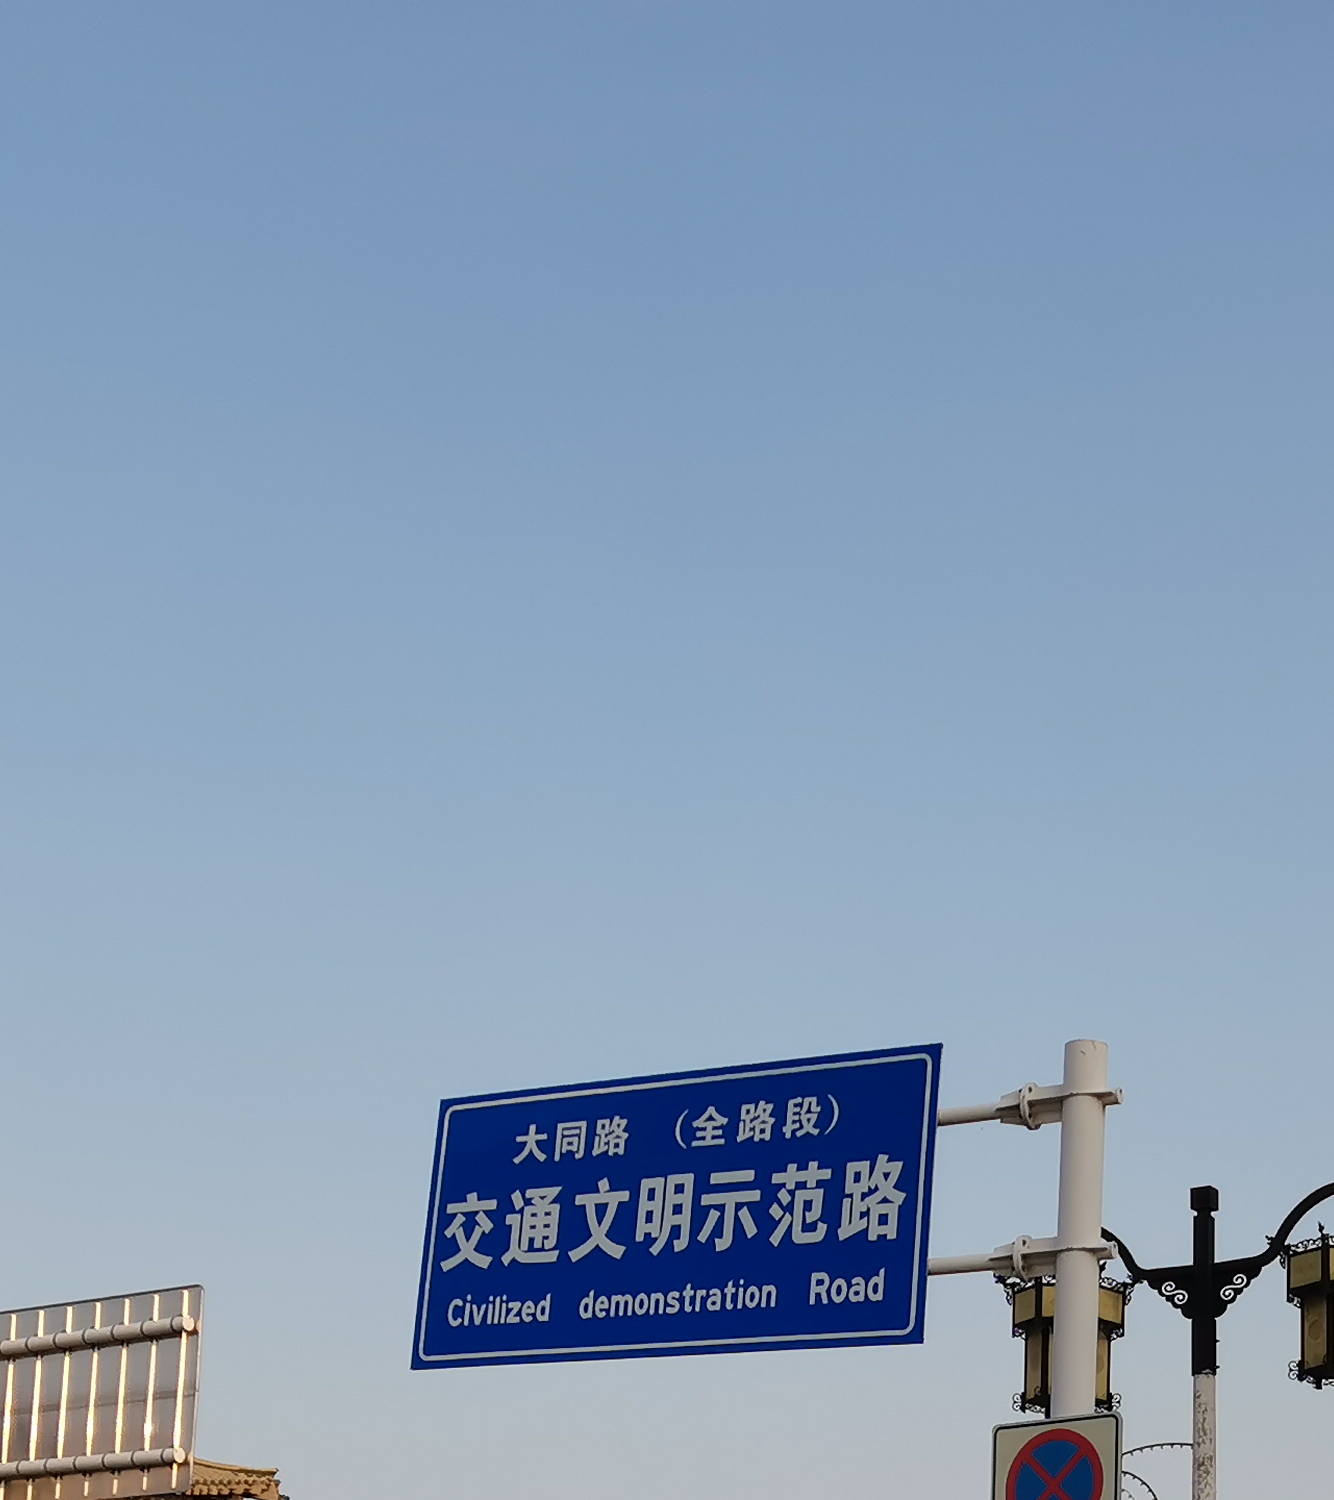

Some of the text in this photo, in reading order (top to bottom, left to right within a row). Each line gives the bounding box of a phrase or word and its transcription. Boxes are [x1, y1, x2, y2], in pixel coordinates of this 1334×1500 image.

[512, 1115, 629, 1164] 大同路
[440, 1154, 907, 1272] 交通文明示范路
[447, 1268, 886, 1328] Civilized demonstration Road
